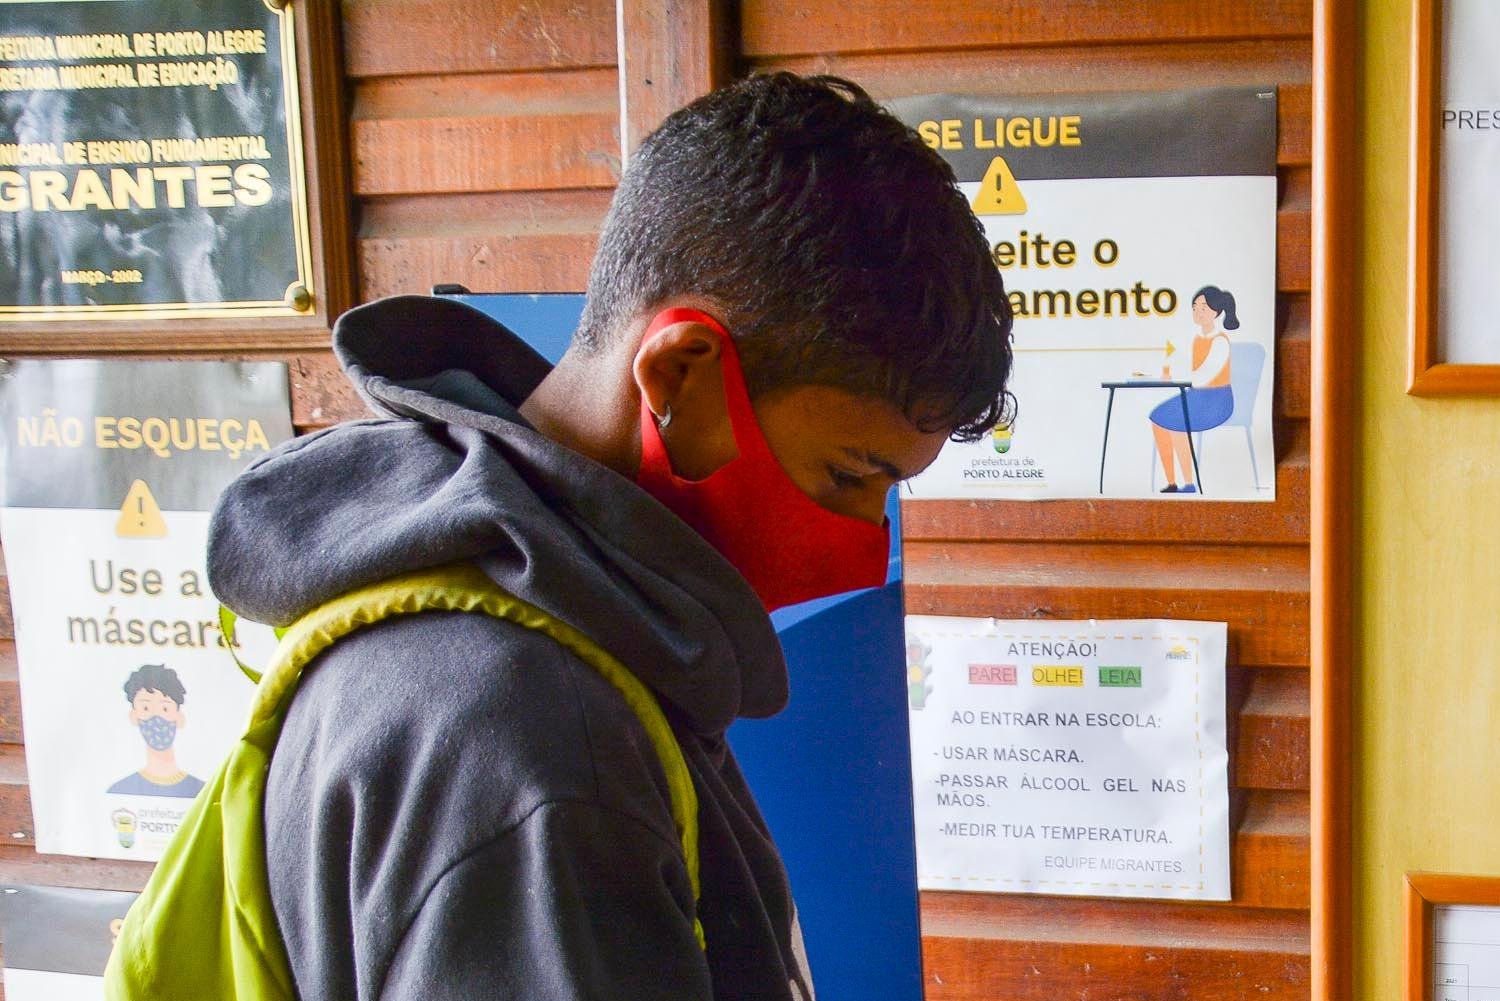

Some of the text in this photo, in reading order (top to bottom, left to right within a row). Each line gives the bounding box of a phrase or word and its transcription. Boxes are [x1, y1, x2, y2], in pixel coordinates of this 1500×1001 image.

[56, 33, 135, 59] MUNICIPAL
[133, 32, 157, 57] DE
[155, 31, 206, 56] PORTO
[207, 29, 267, 55] ALEGRE
[60, 64, 139, 90] MUNICIPAL
[137, 63, 160, 87] DE
[159, 56, 238, 91] EDUCAÇÃO
[919, 116, 1082, 150] SE LIGUE
[64, 140, 88, 165] DE
[87, 138, 151, 165] ENSINO
[151, 135, 272, 162] FUNDAMENTAL
[1094, 238, 1119, 268] o
[61, 270, 105, 286] MARÇO
[17, 408, 271, 460] NÃO ESQUEÇA
[1022, 456, 1035, 466] de
[963, 469, 1045, 479] PORTO ALEGRE
[89, 558, 203, 598] Use a
[67, 610, 242, 650] máscara
[1008, 639, 1097, 660] ATENÇÃO!
[969, 667, 1142, 684] PARE! OLHE! LEIA!
[952, 711, 1161, 729] AO ENTRAR NA ESCOLA:
[943, 746, 987, 761] USAR
[993, 745, 1084, 763] MÁSCARA.
[935, 772, 1186, 793] -PASSAR ÁLCOOL GEL NAS
[937, 790, 990, 808] MÃOS.
[939, 823, 1173, 844] -MEDIR TUA TEMPERATURA.
[1044, 855, 1186, 873] EQUIPE MIGRANTES.
